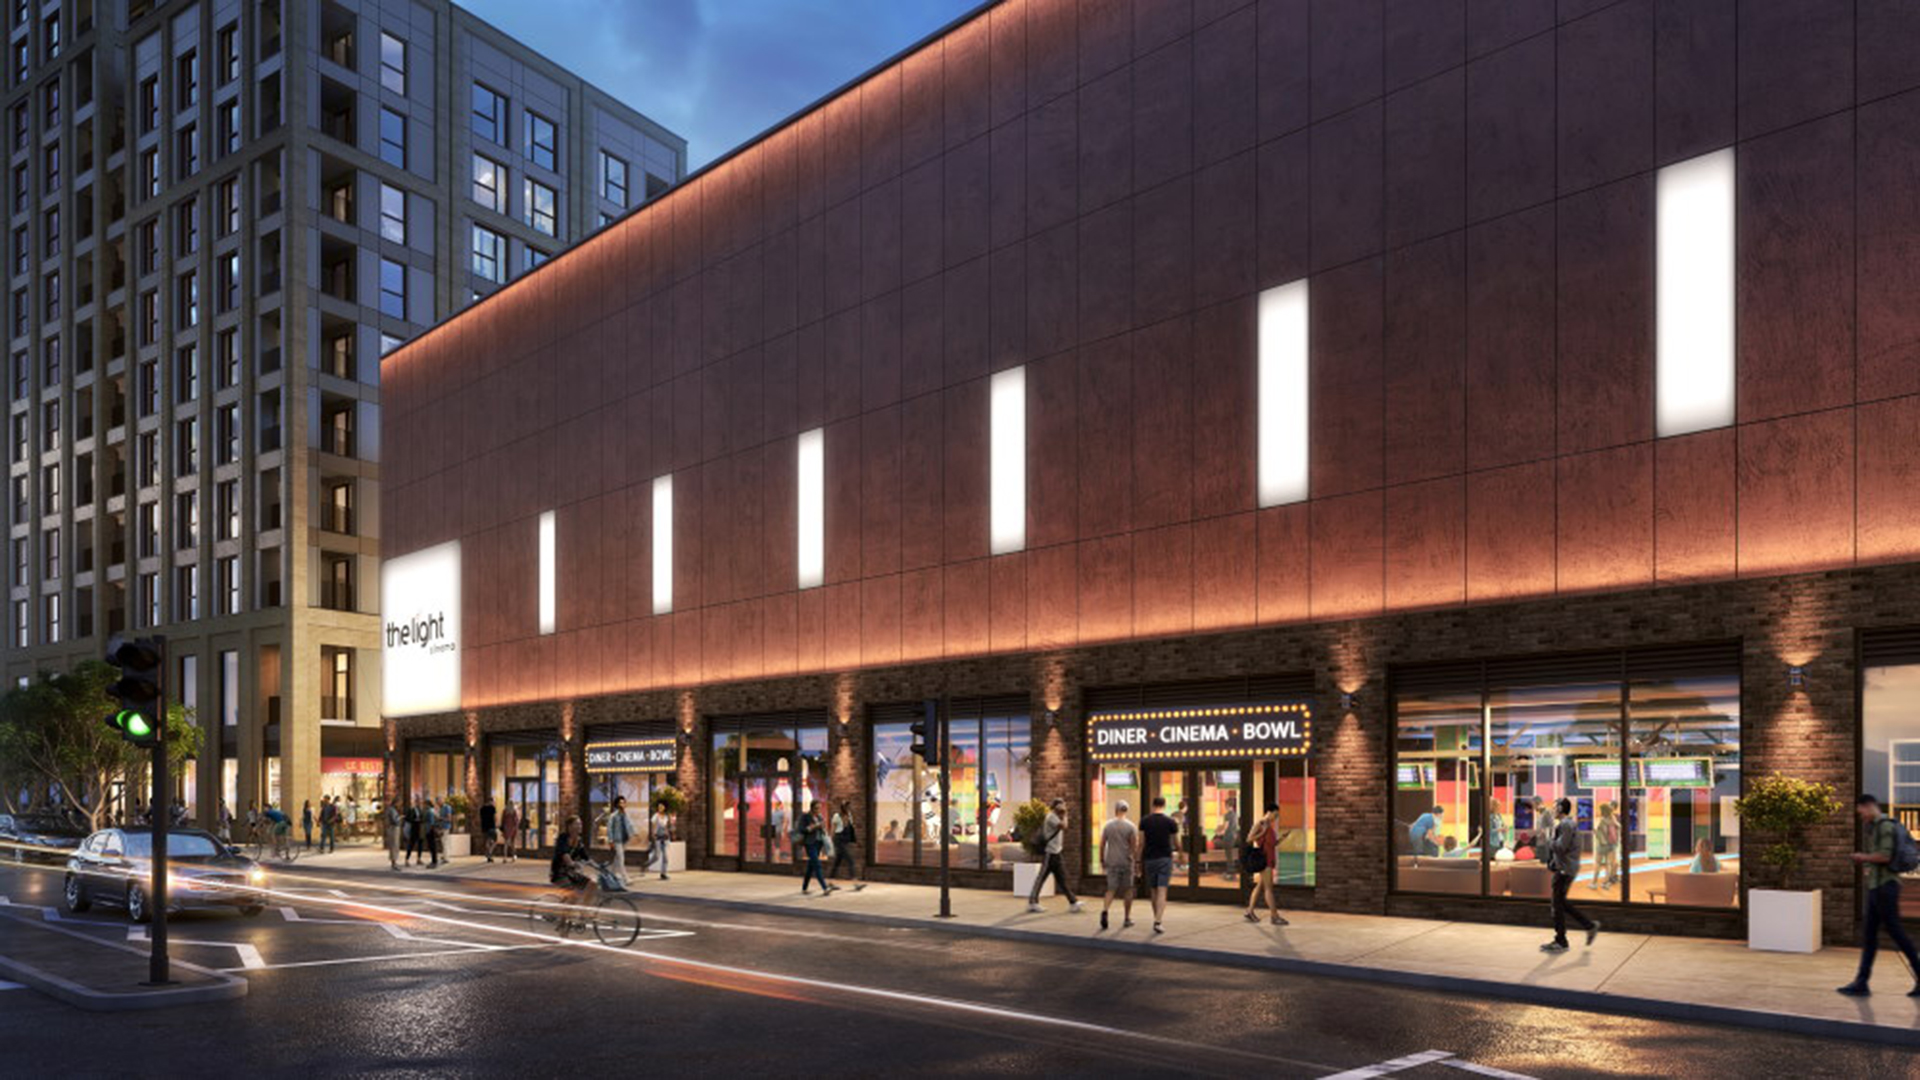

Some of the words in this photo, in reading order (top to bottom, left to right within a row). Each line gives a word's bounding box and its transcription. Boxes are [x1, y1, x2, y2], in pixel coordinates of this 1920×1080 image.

[1098, 728, 1147, 745] DINER
[1159, 724, 1229, 743] CINEMA
[1243, 720, 1302, 740] BOWL
[589, 752, 611, 763] DINER
[615, 751, 645, 762] CINEMA
[650, 749, 673, 761] BOWL
